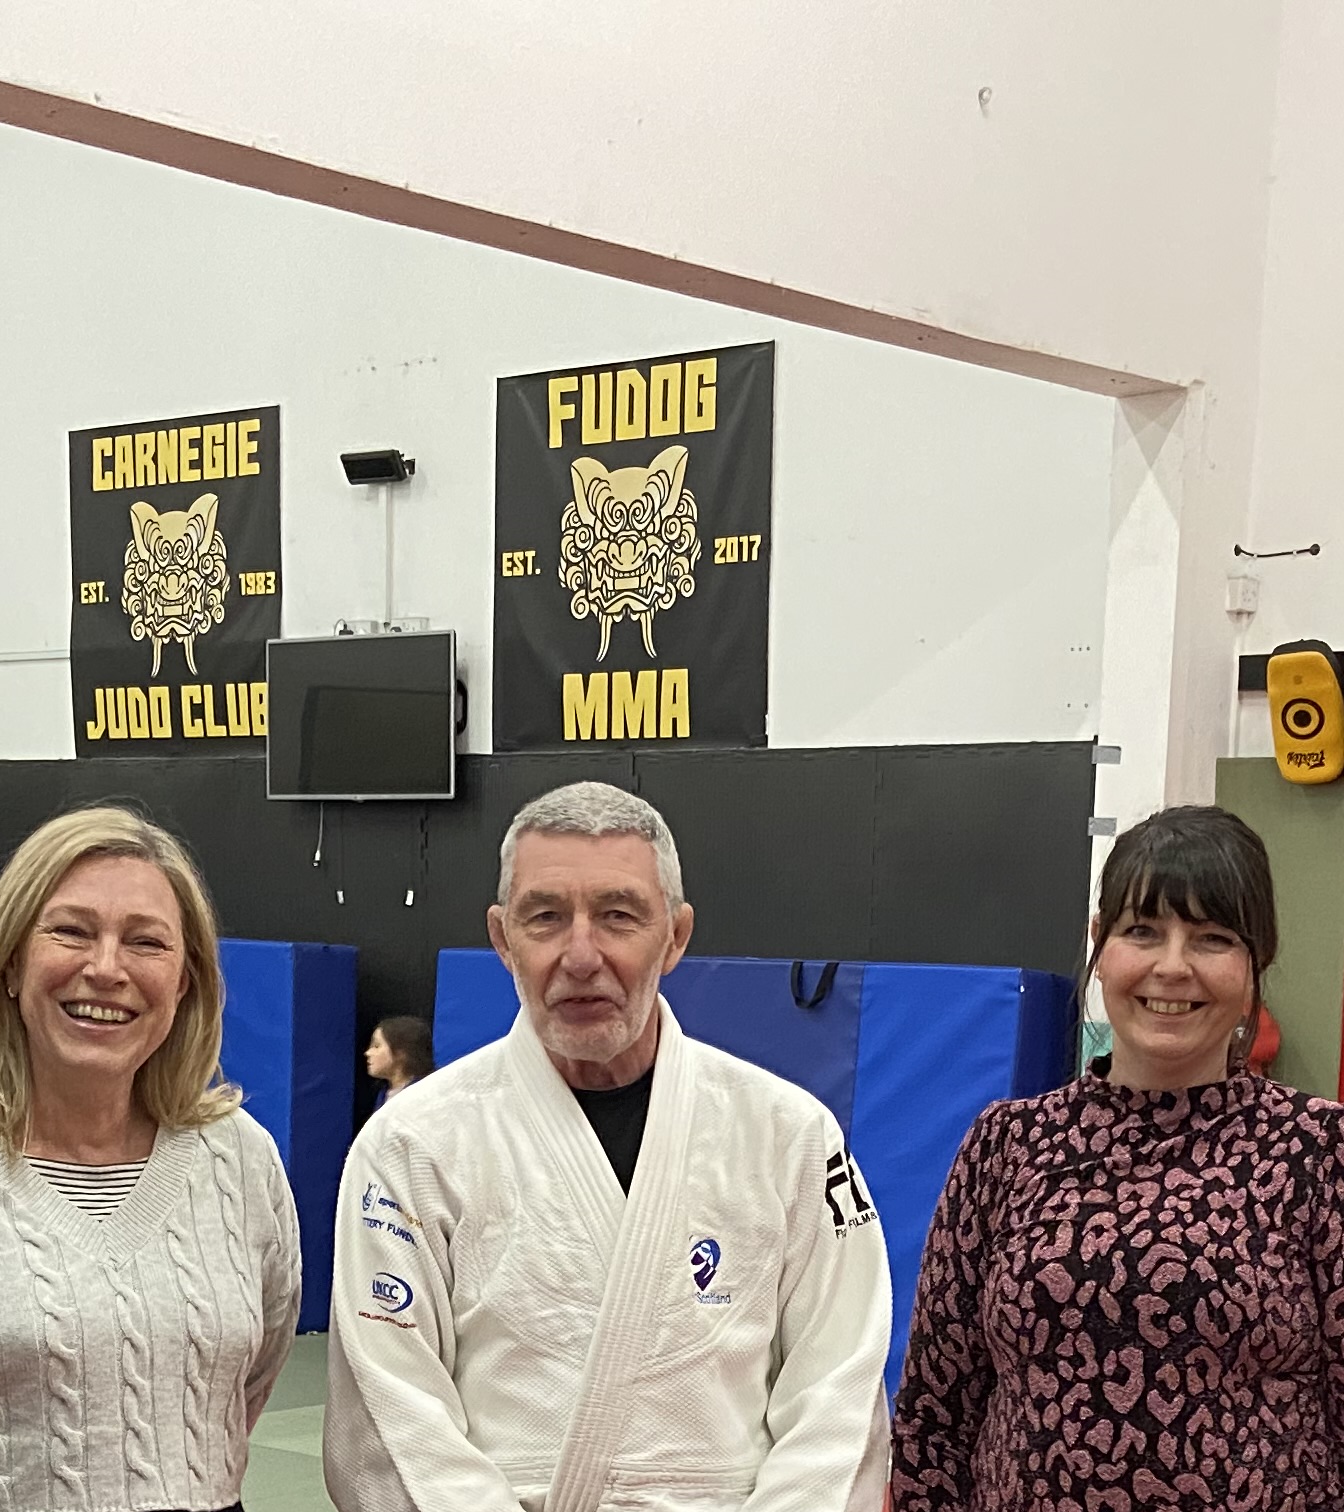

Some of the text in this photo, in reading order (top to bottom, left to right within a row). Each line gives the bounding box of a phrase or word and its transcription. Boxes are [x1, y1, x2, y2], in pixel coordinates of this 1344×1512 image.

[547, 356, 717, 449] FUDOG
[92, 417, 261, 492] CARNEGIE
[80, 571, 276, 604] EST. 1983
[502, 534, 762, 577] EST. 2017
[86, 681, 268, 740] JUDO CLUB
[562, 668, 691, 741] MMA
